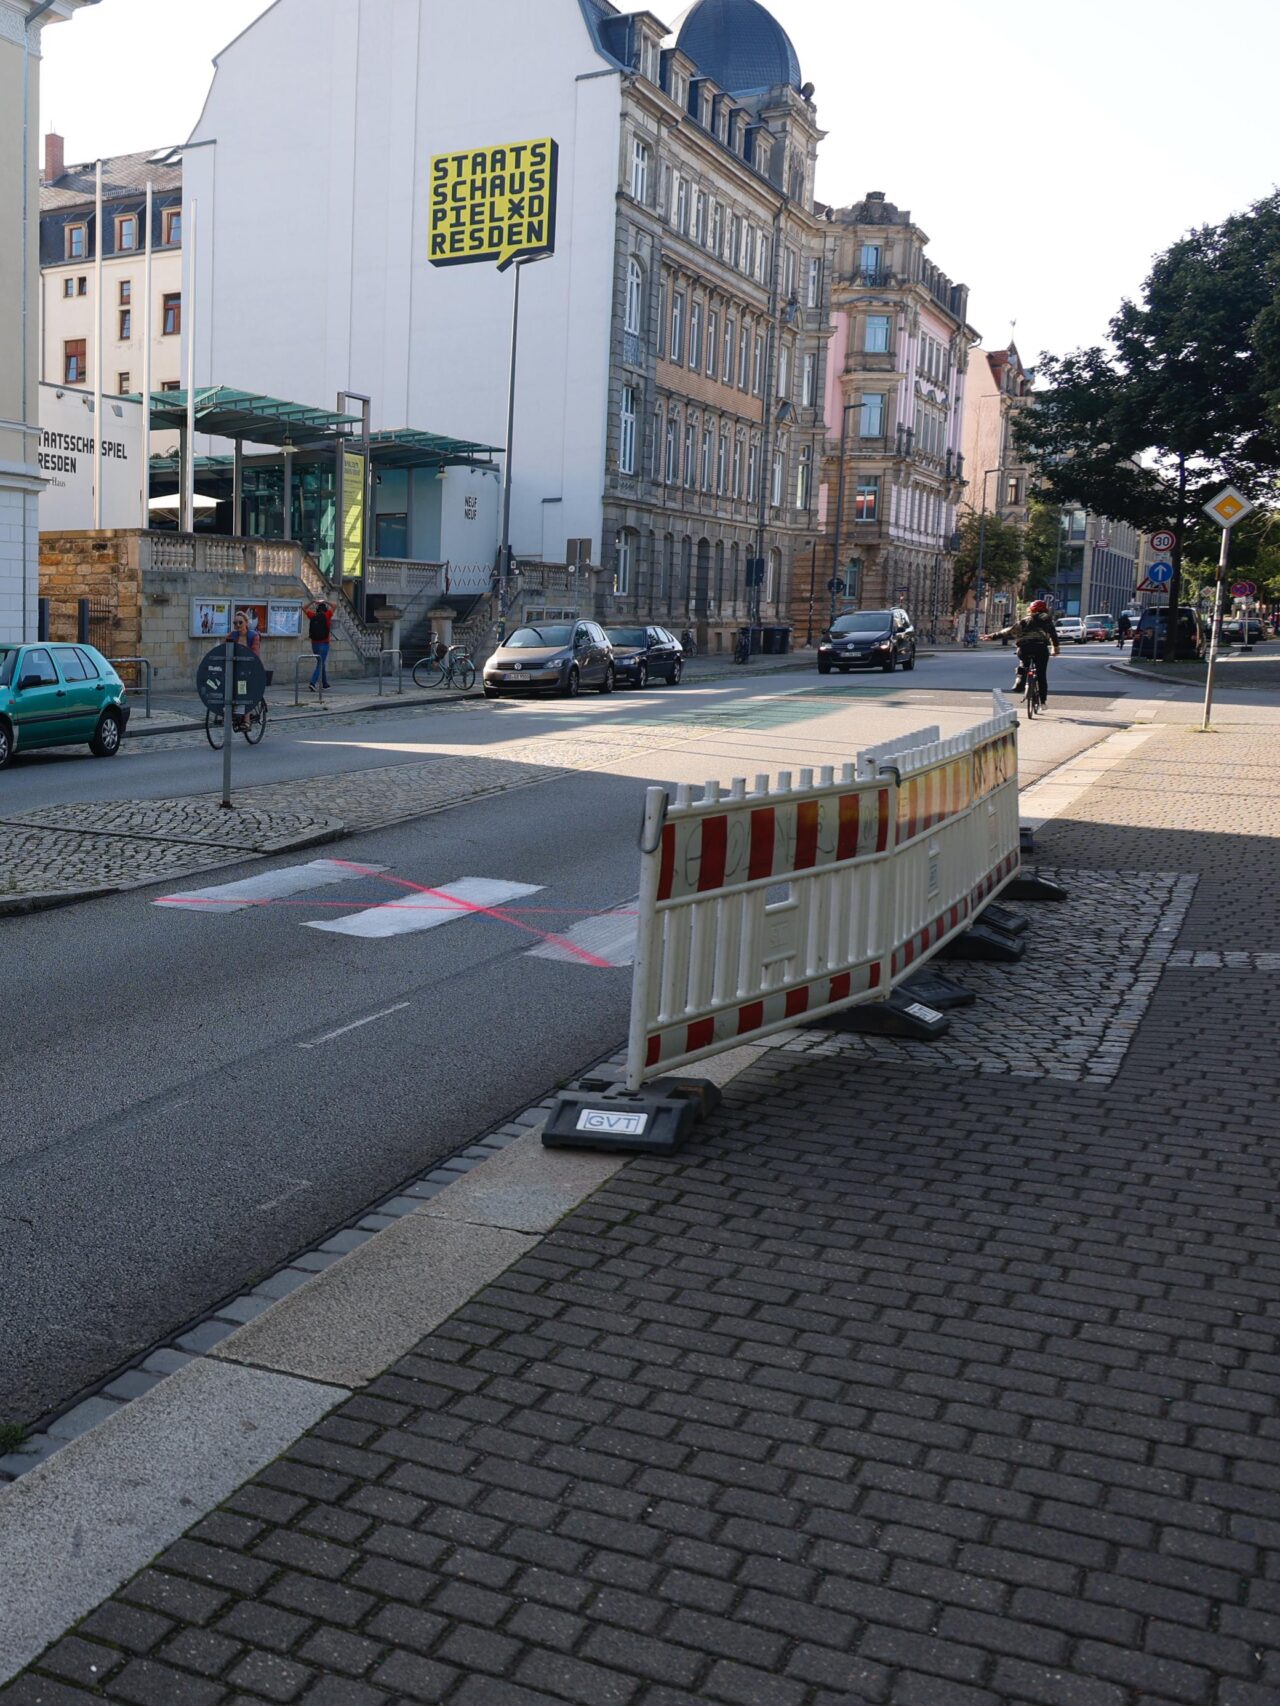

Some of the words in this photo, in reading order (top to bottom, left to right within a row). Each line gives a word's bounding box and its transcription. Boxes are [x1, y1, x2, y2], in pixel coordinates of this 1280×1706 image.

[433, 142, 547, 182] STAATS
[432, 168, 545, 206] SCHAUS
[431, 219, 544, 256] RESDEN
[38, 452, 77, 473] RESDEN
[1155, 536, 1169, 547] 30
[588, 1115, 638, 1129] GVT
